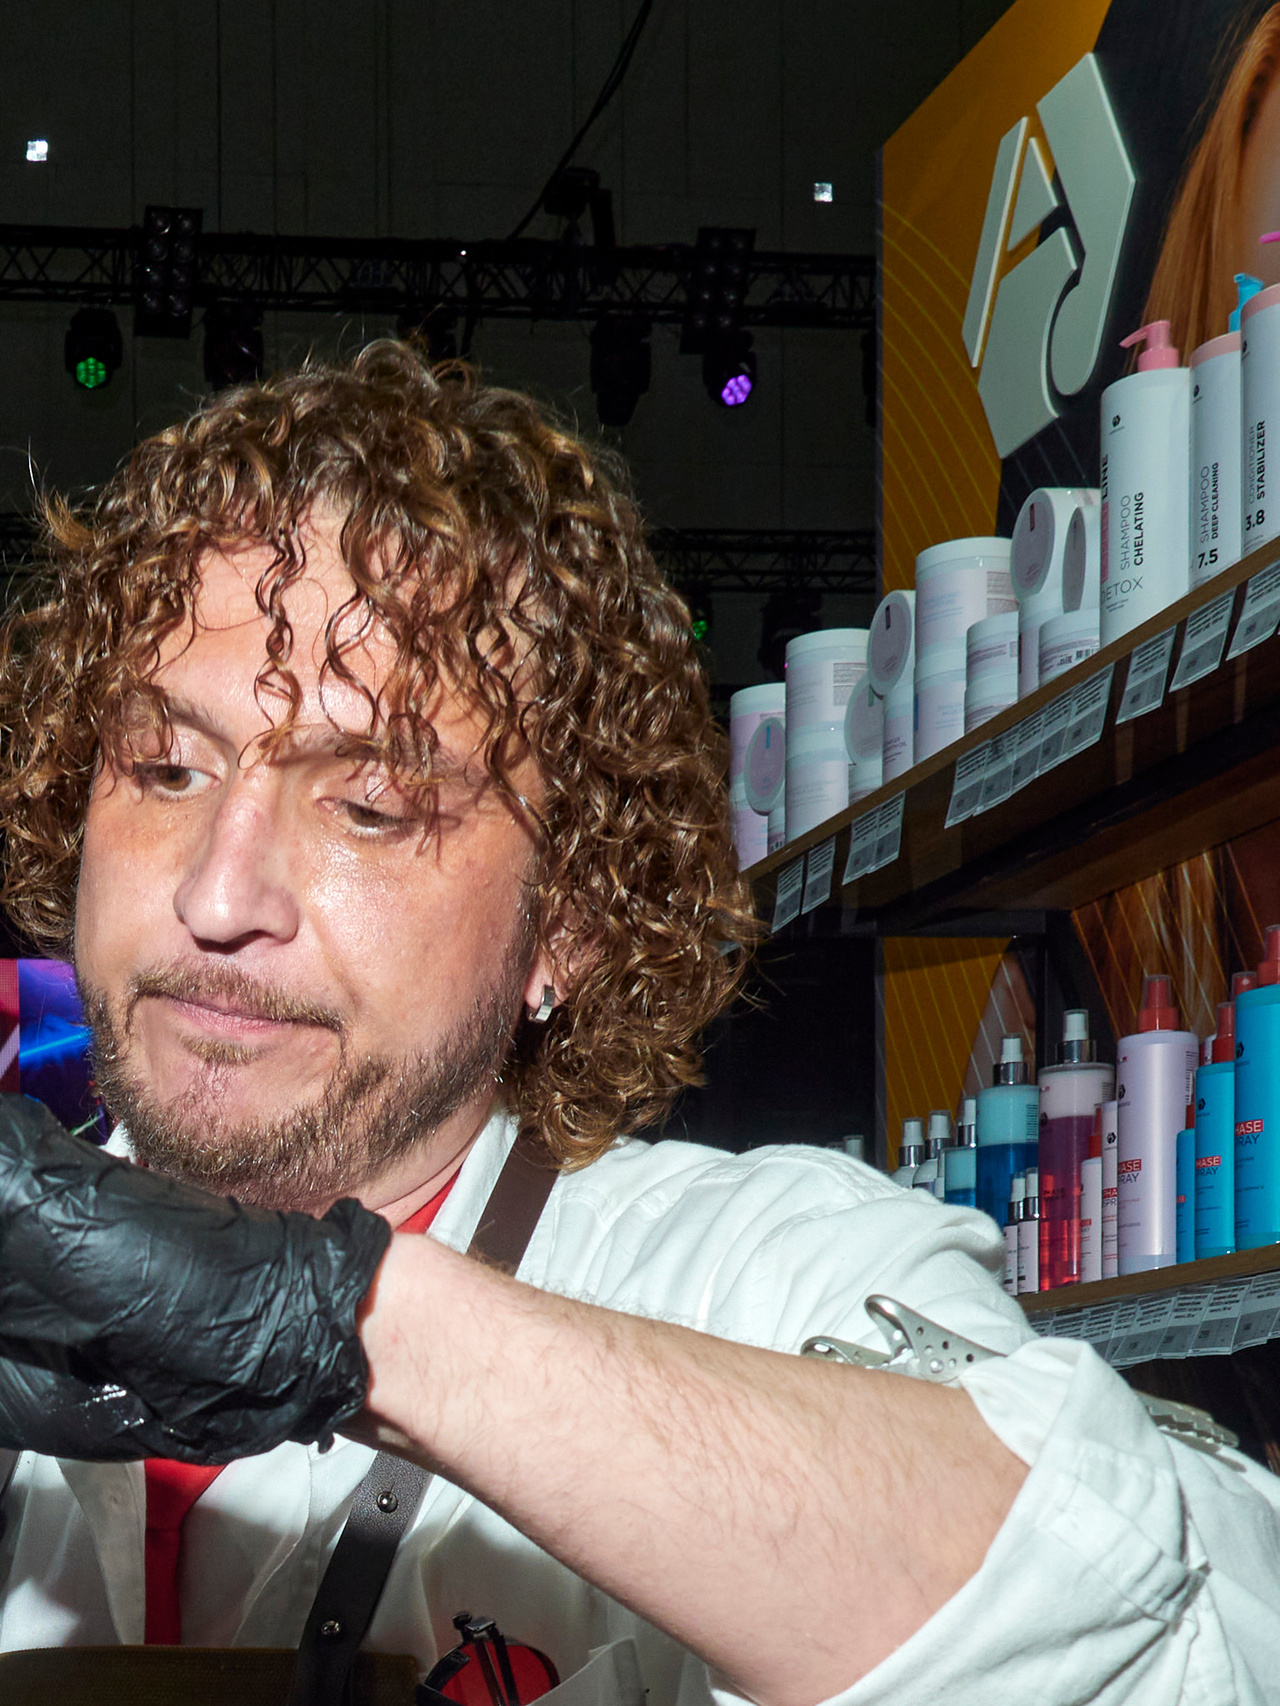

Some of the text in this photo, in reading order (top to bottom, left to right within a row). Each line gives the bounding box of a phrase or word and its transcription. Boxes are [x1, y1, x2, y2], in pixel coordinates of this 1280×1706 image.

[1256, 420, 1266, 500] STABILIZER
[1120, 495, 1131, 570] SHAMPOO
[1134, 492, 1144, 566] CHELATING
[1200, 466, 1210, 544] SHAMPOO
[1245, 509, 1265, 531] 3.8
[1197, 548, 1219, 569] 7.5
